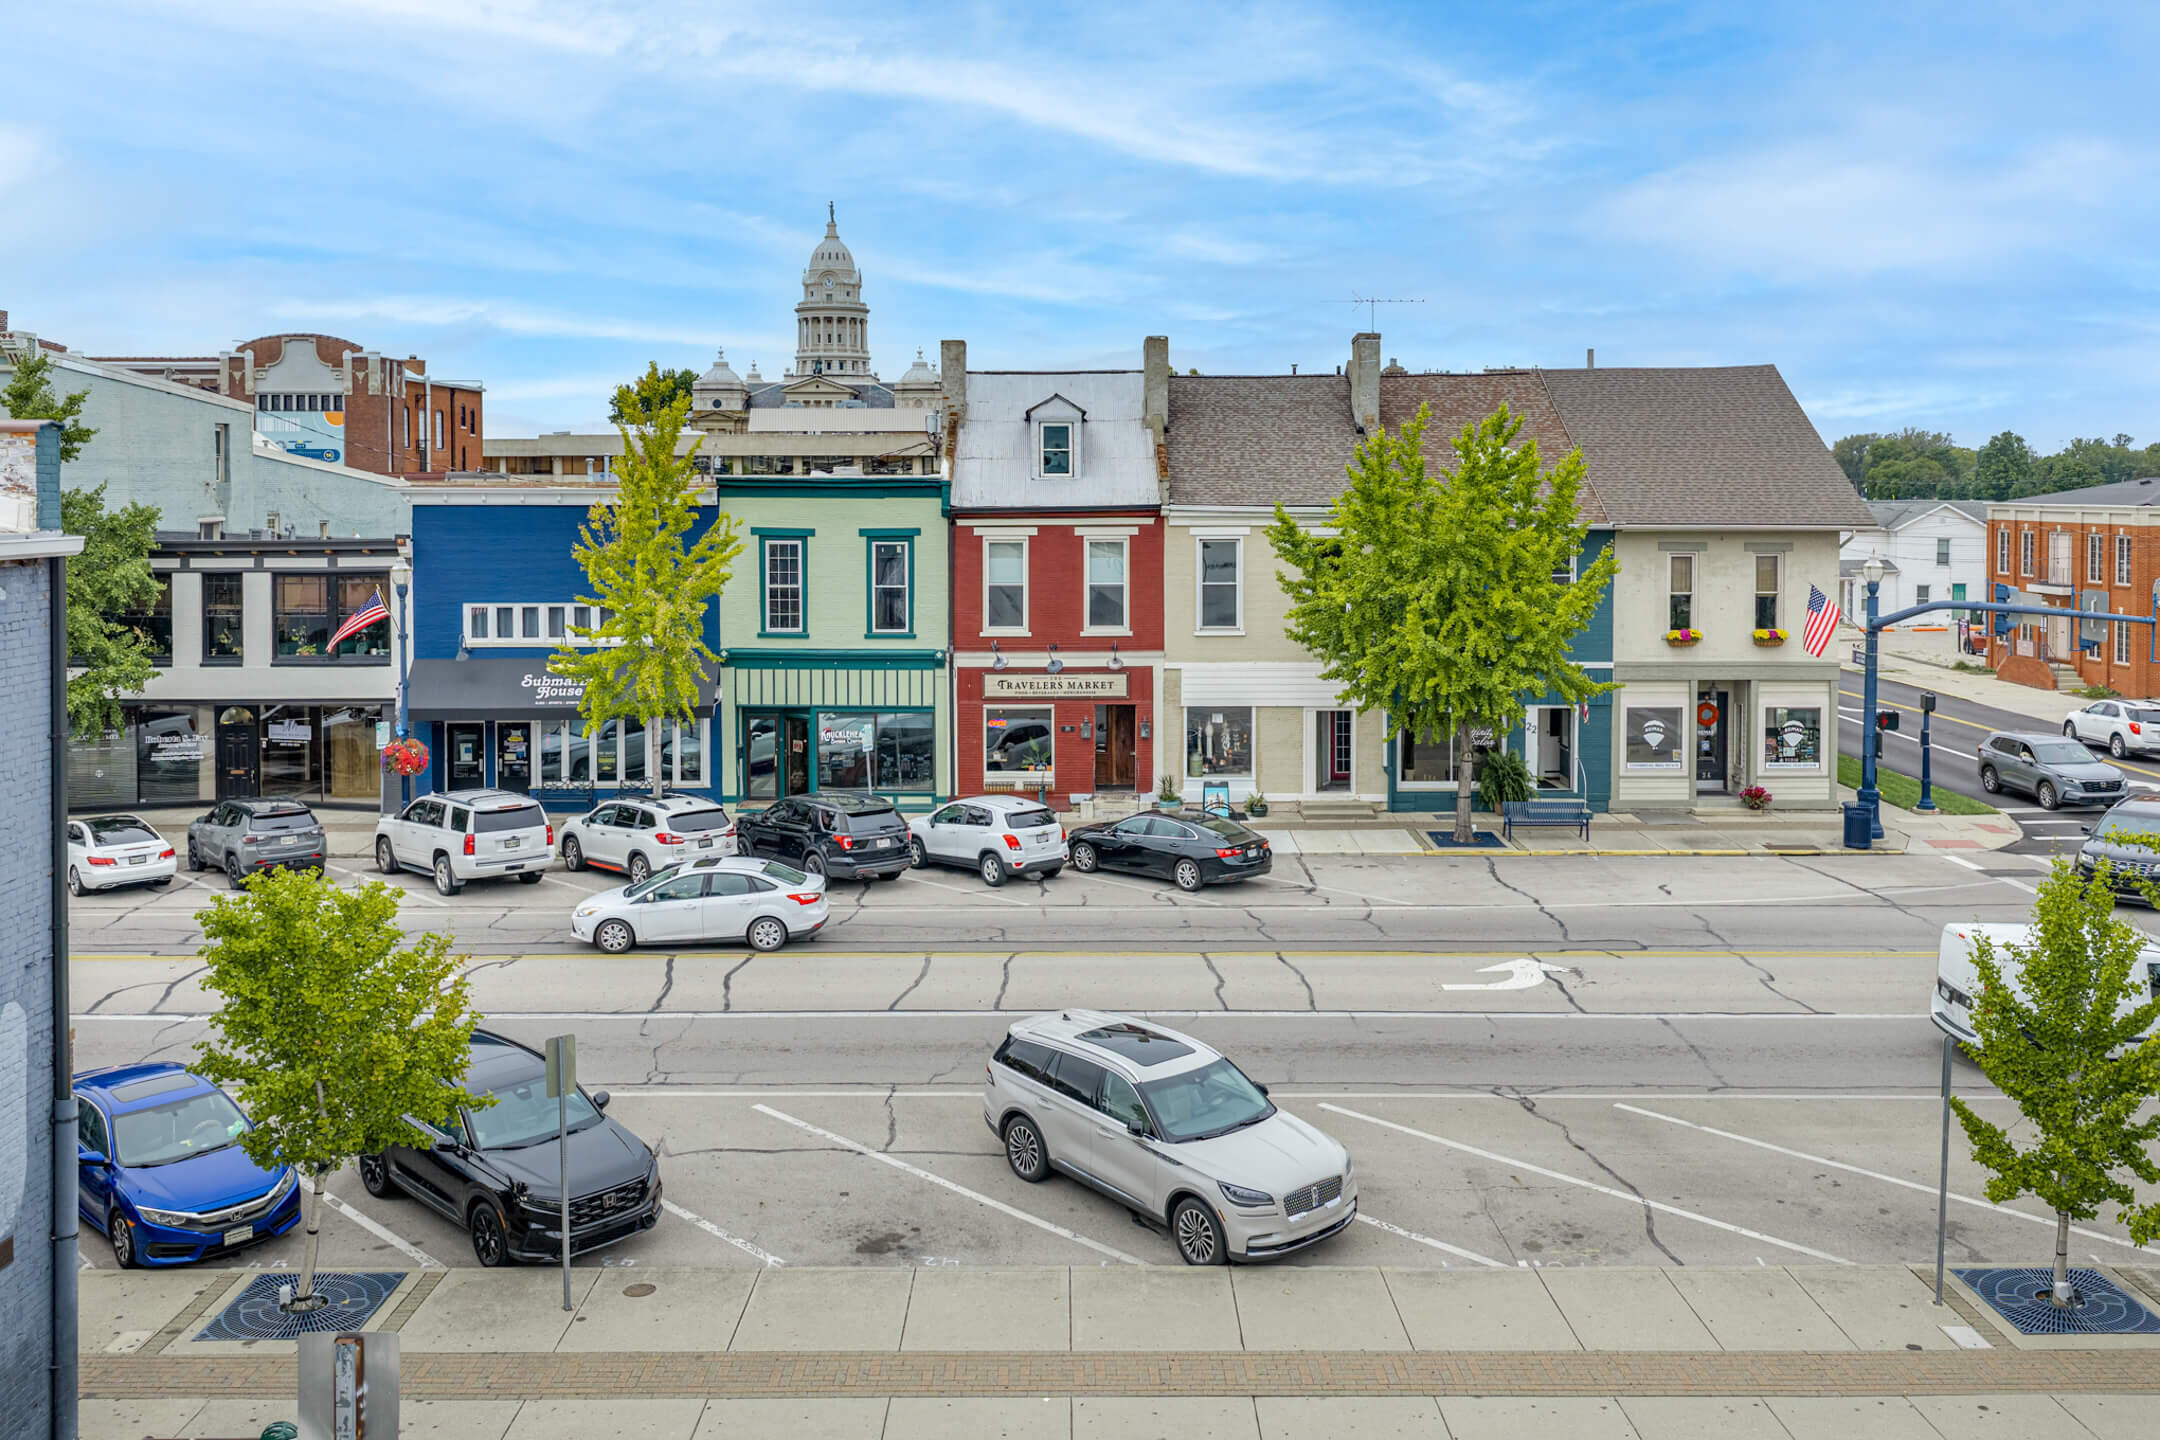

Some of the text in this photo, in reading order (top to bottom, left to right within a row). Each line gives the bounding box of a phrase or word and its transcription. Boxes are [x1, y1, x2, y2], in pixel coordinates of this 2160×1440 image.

[521, 673, 592, 687] Subma
[997, 680, 1115, 690] TRAVELERS MARKET
[535, 686, 583, 699] House
